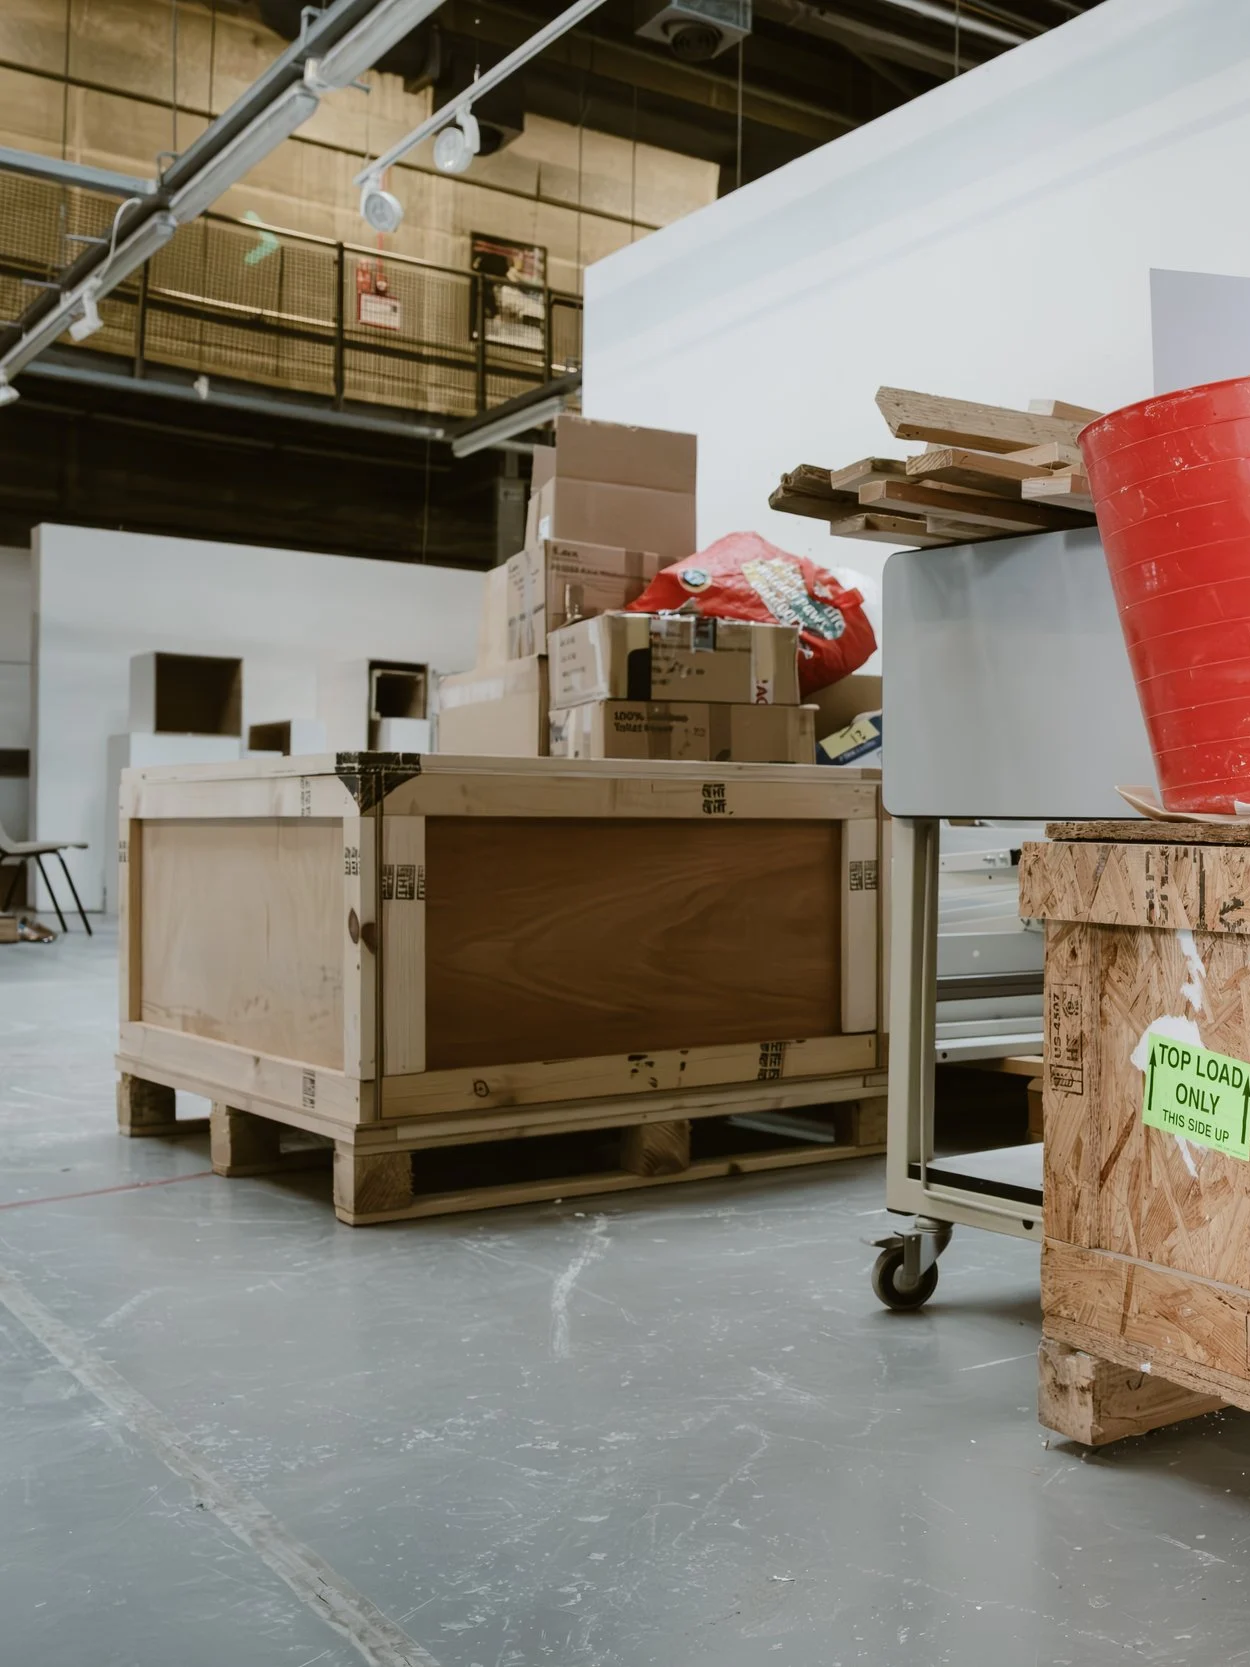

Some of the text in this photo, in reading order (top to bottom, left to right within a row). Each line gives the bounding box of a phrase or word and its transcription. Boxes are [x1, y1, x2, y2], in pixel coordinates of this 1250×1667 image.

[1159, 1043, 1243, 1089] TOP LOAD
[1175, 1082, 1220, 1115] ONLY
[1163, 1108, 1230, 1143] THIS SIDE UP
